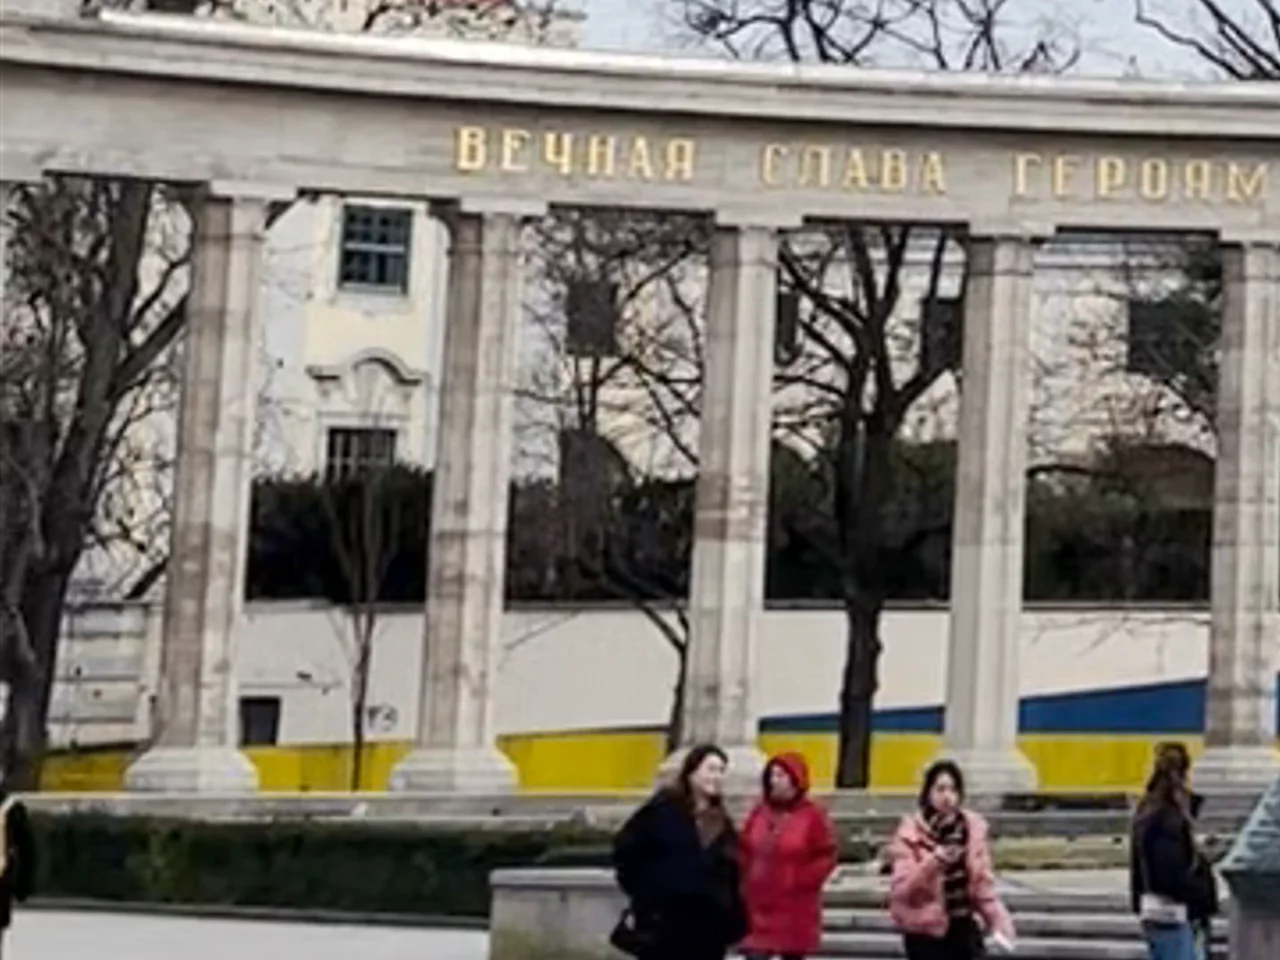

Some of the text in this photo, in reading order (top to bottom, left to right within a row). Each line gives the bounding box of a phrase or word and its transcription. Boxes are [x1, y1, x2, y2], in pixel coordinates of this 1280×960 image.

[456, 125, 695, 181] ВЕЧНАЯ
[761, 141, 948, 194] СЛАВА
[1013, 151, 1272, 202] ГЕРОЯМ
